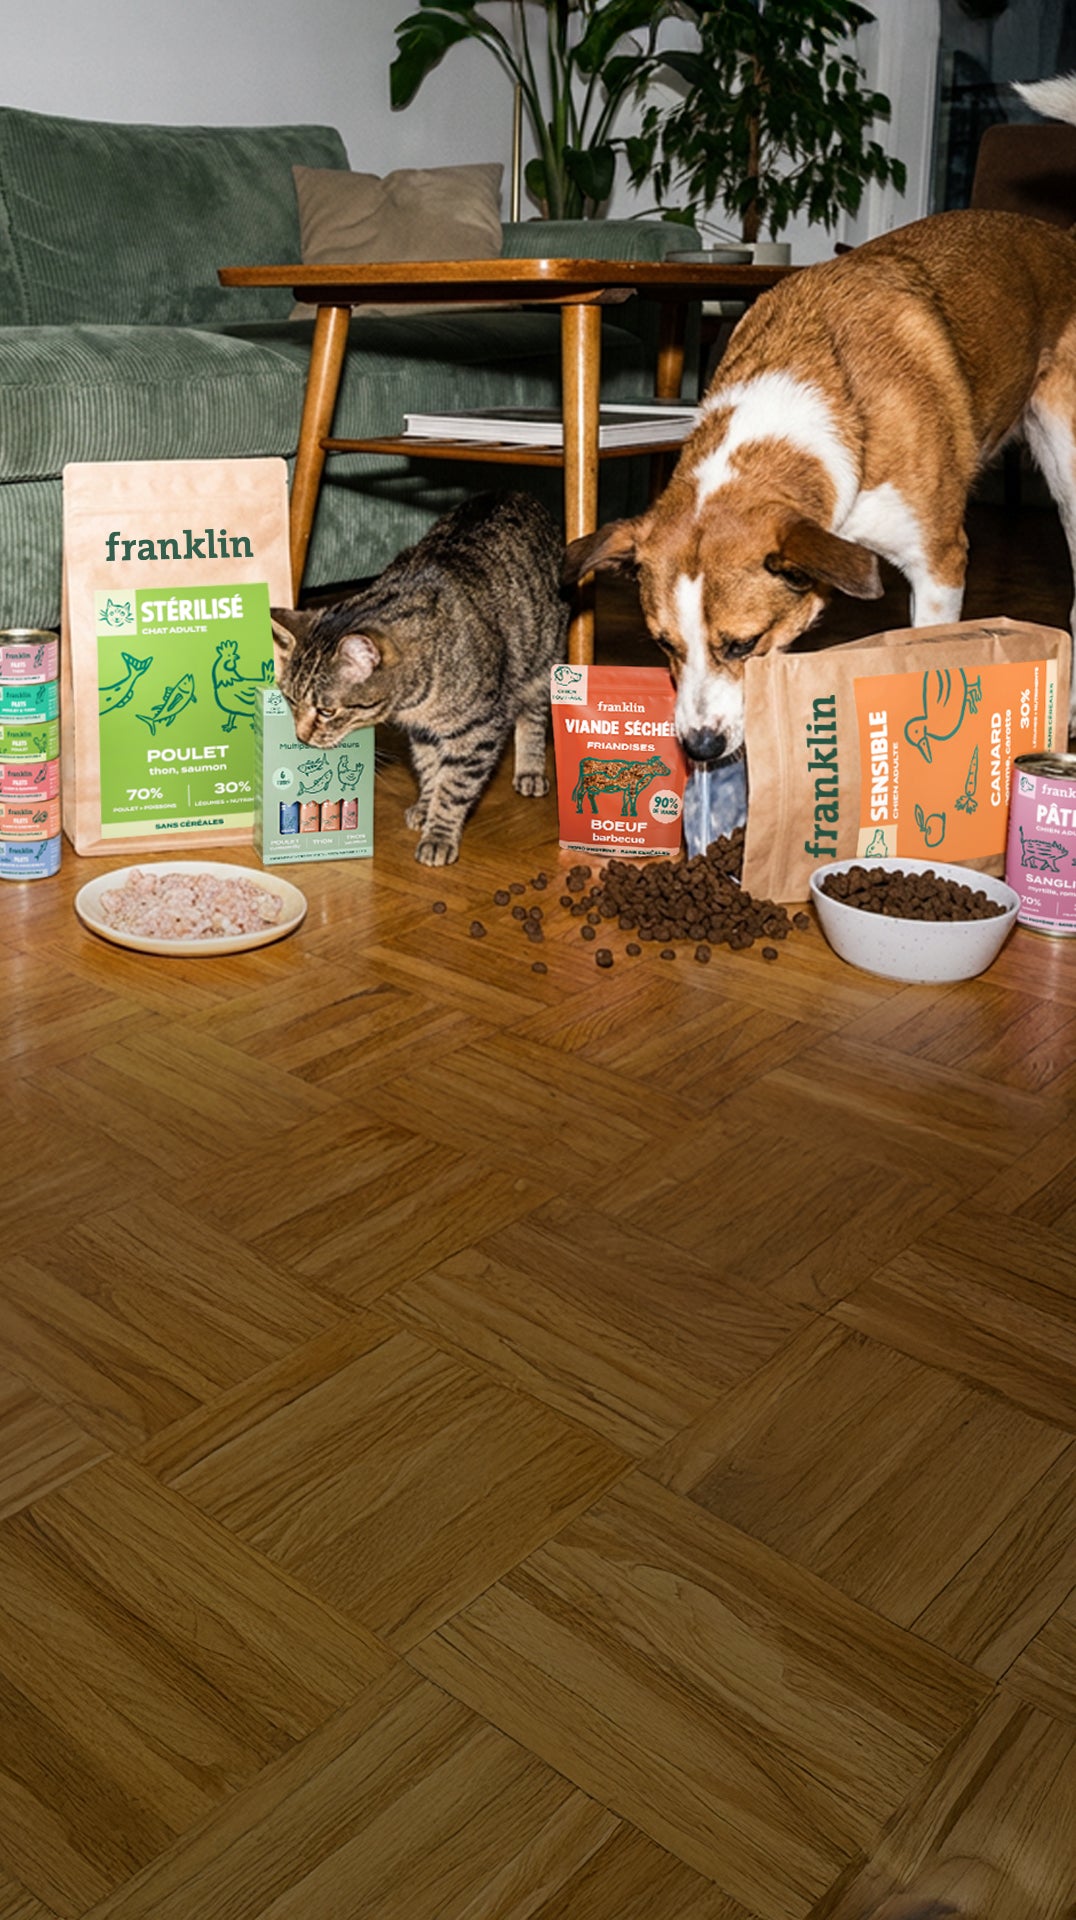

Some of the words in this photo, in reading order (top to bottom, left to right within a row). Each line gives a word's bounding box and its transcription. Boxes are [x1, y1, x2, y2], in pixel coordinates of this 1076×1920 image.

[105, 528, 254, 561] franklin
[140, 593, 244, 622] STÉRILISÉ
[142, 627, 168, 635] CHAT
[169, 625, 208, 634] ADULTE
[597, 701, 645, 713] franklin
[1020, 688, 1031, 729] 30%
[564, 718, 619, 735] VIANDE
[586, 741, 656, 752] FRIANDISES
[147, 745, 229, 763] POULET
[990, 712, 1002, 807] CANARD
[149, 766, 179, 776] thon,
[181, 762, 227, 774] saumon
[868, 710, 889, 822] SENSIBLE
[804, 694, 840, 858] franklin
[126, 787, 164, 801] 70%
[214, 780, 251, 795] 30%
[1041, 783, 1076, 799] frank
[112, 805, 139, 813] POULET
[194, 799, 225, 807] LÉGUMES
[654, 796, 679, 809] 90%
[180, 818, 225, 828] CÉRÉALES
[591, 819, 648, 833] BOEUF
[1035, 825, 1060, 834] CHIEN
[592, 833, 645, 844] barbecue
[1025, 873, 1076, 889] SANGLI
[1021, 894, 1042, 907] 70%
